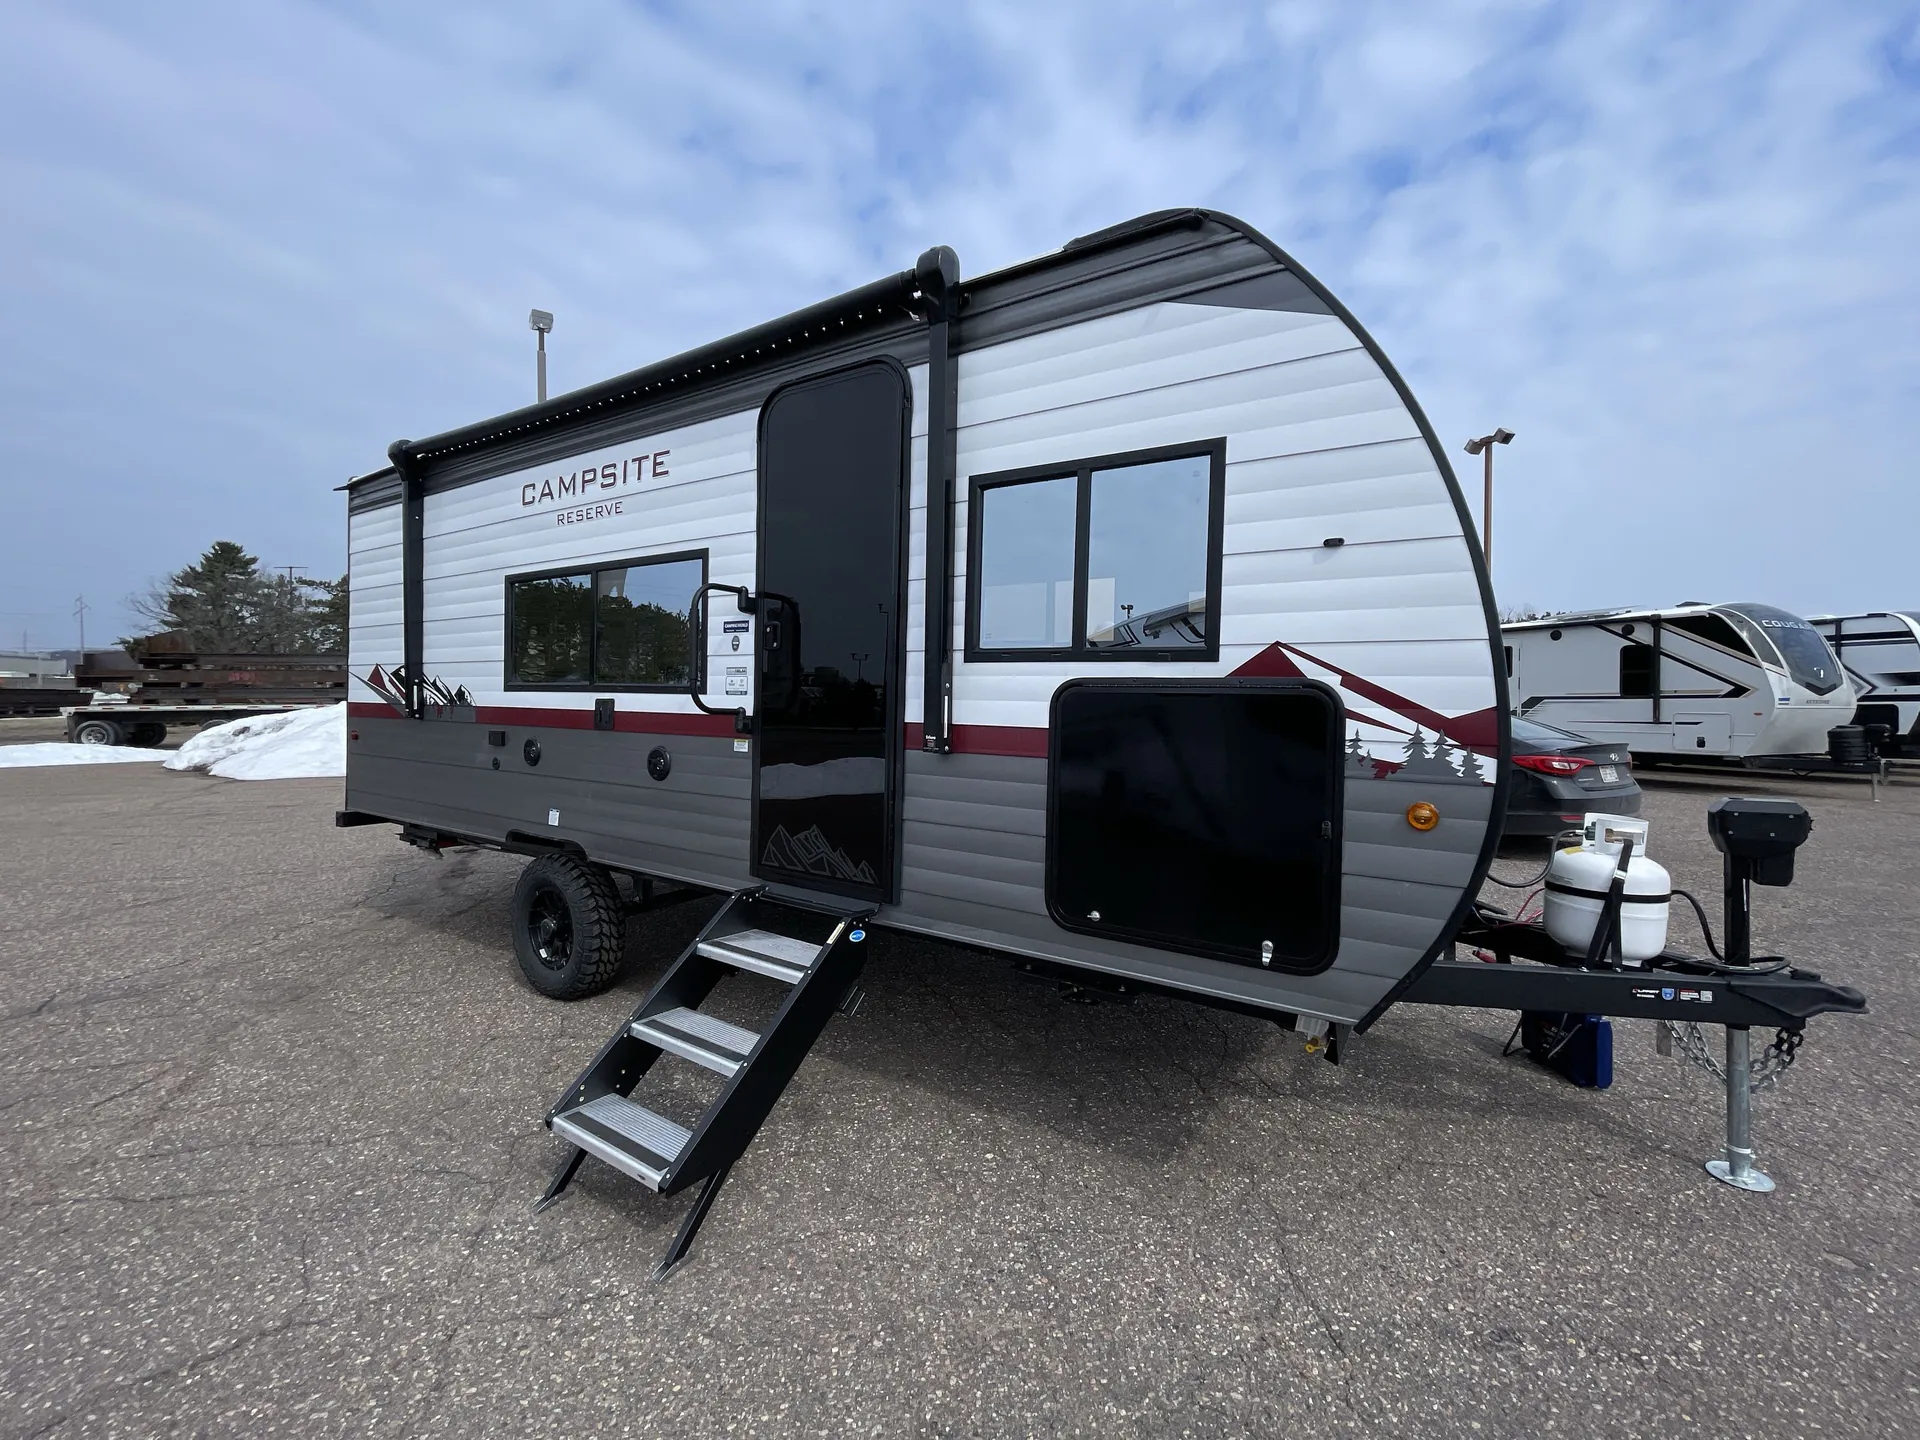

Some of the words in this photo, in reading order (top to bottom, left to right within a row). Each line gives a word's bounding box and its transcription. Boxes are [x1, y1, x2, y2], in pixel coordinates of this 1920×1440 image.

[522, 450, 671, 506] CAMPSITE
[556, 501, 624, 526] RESERVE
[1761, 619, 1814, 631] COUGAR
